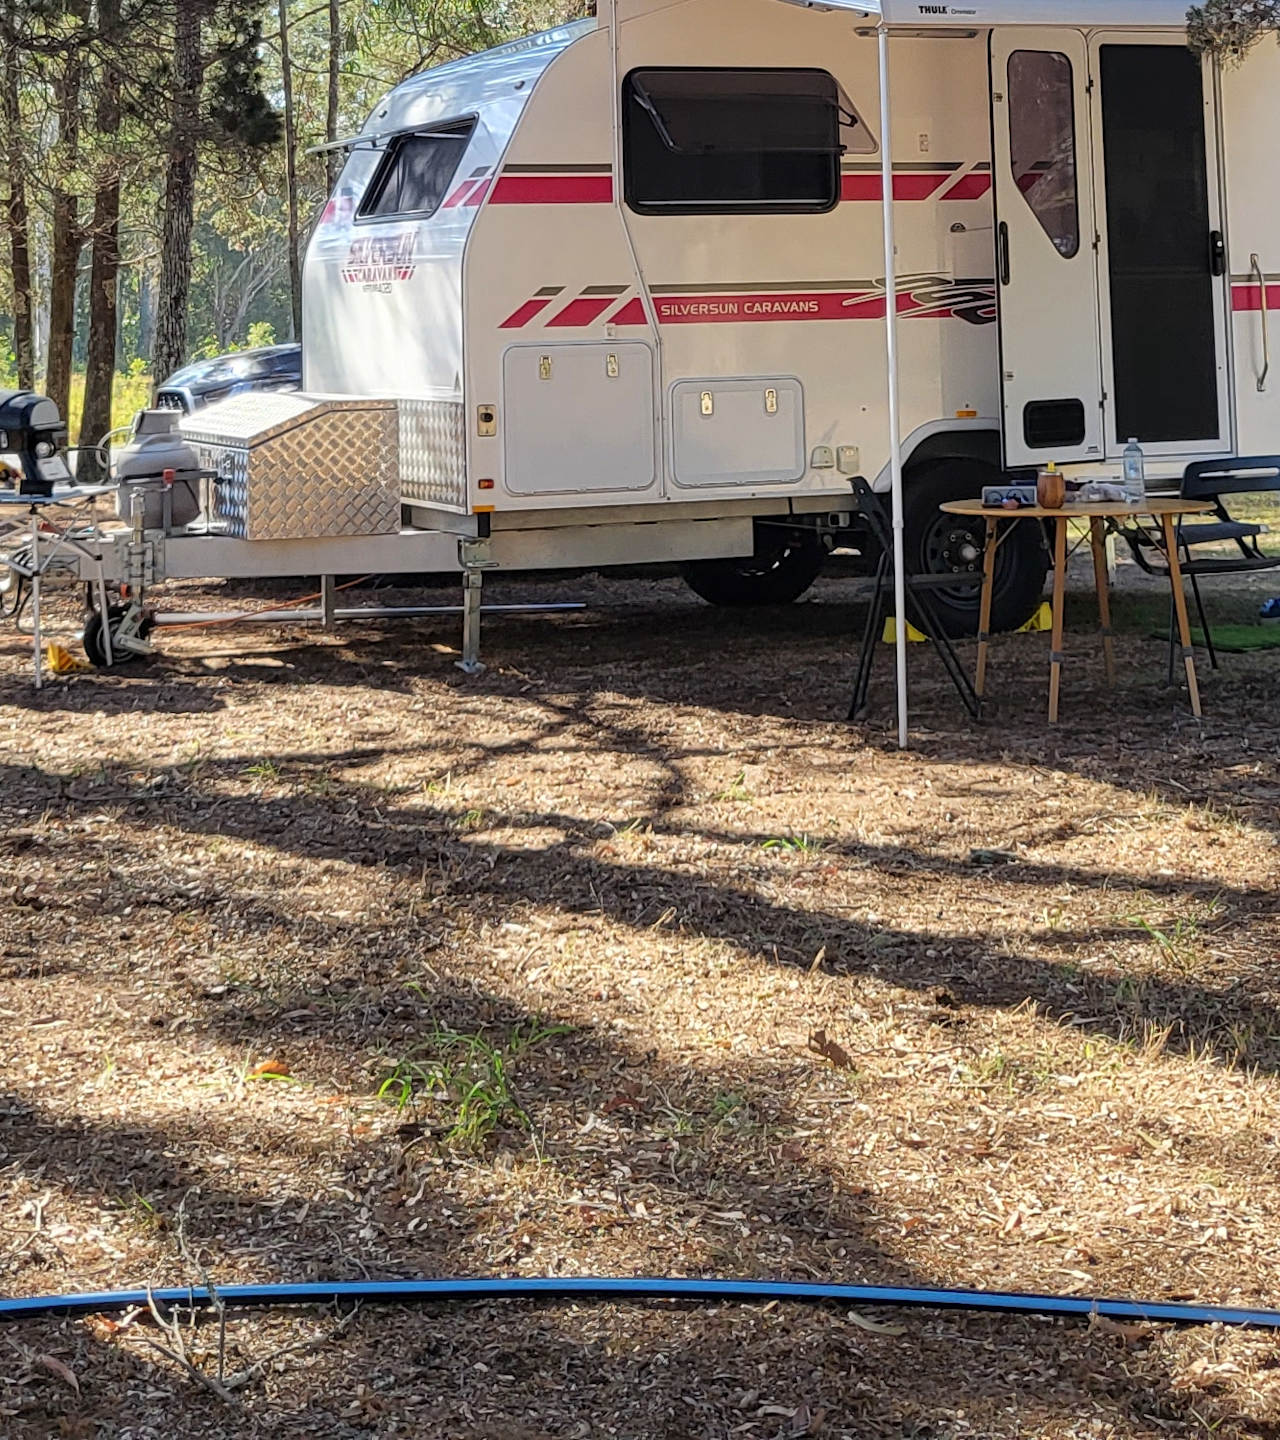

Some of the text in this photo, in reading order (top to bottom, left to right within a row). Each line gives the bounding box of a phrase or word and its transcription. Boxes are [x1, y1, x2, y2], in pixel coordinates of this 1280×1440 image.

[918, 5, 949, 14] THULE
[660, 301, 819, 316] SILVERSUN CARAVANS
